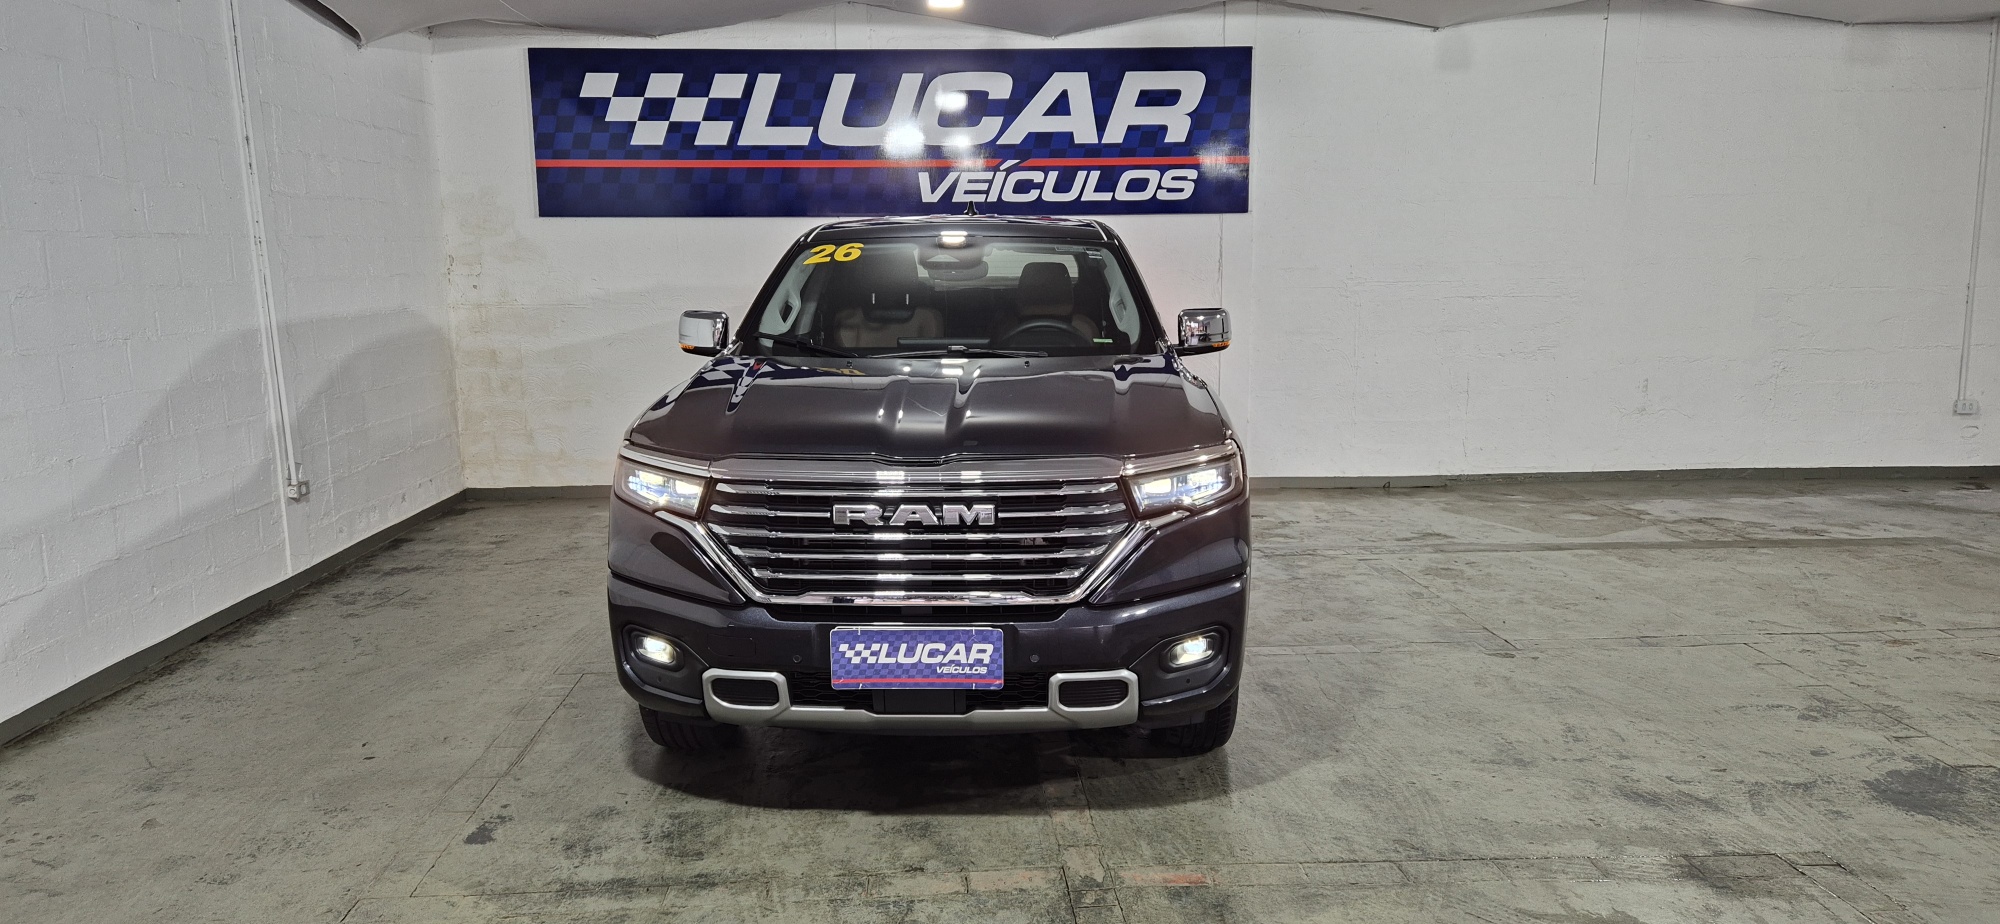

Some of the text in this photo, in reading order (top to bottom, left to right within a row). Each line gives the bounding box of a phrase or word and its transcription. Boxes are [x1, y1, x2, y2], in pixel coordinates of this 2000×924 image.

[737, 70, 1206, 147] LUCAR
[917, 161, 1199, 203] VEÍCULOS
[803, 243, 864, 264] 26
[832, 504, 996, 526] RAM
[877, 643, 994, 664] LUCAR
[936, 663, 988, 674] VEÍCULOS
